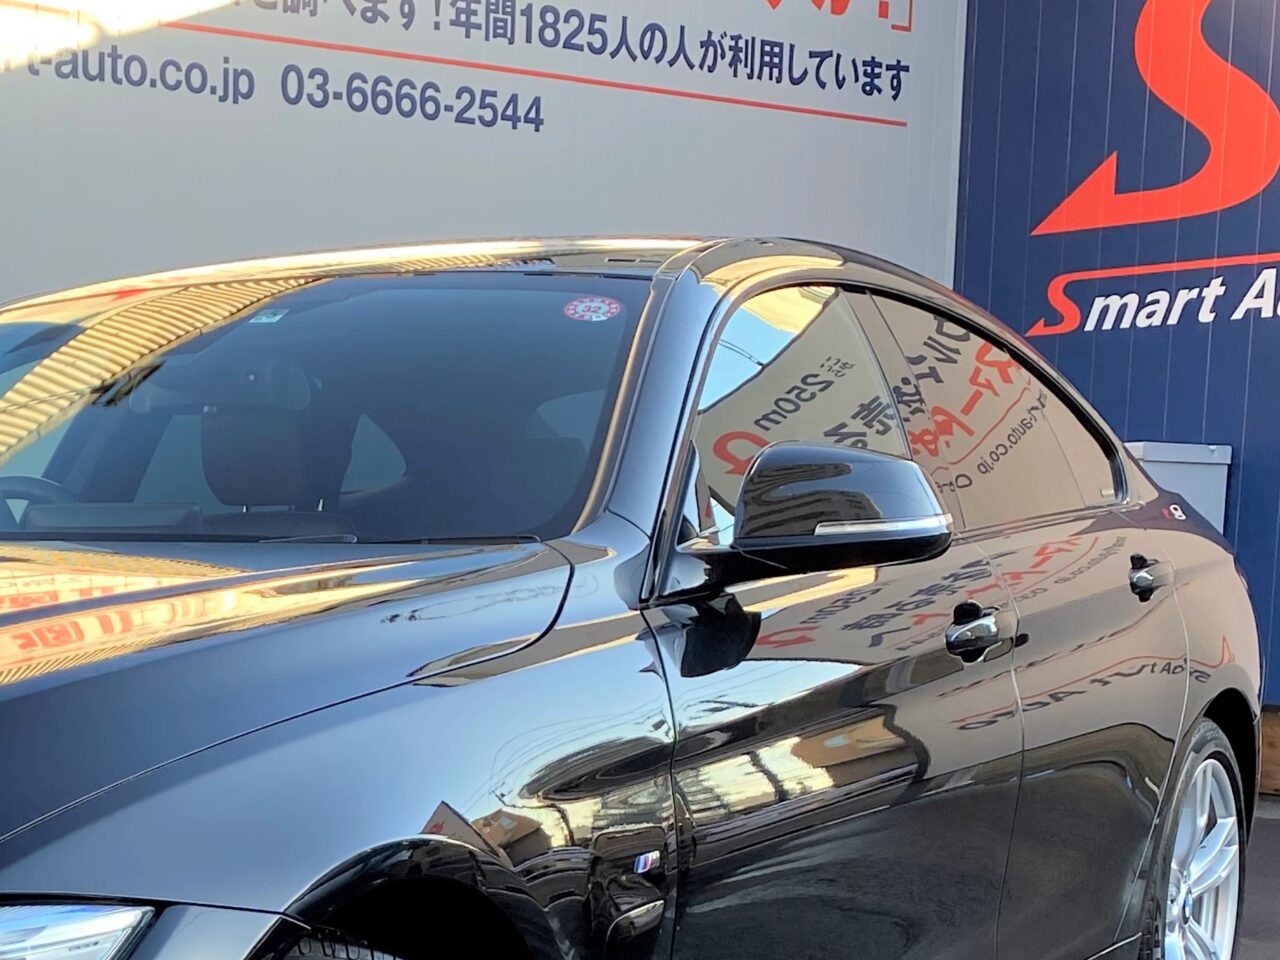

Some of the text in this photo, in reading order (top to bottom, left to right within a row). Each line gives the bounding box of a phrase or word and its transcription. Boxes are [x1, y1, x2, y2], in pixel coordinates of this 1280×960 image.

[280, 63, 544, 132] 03-6666-2544
[1024, 266, 1280, 338] Smart A
